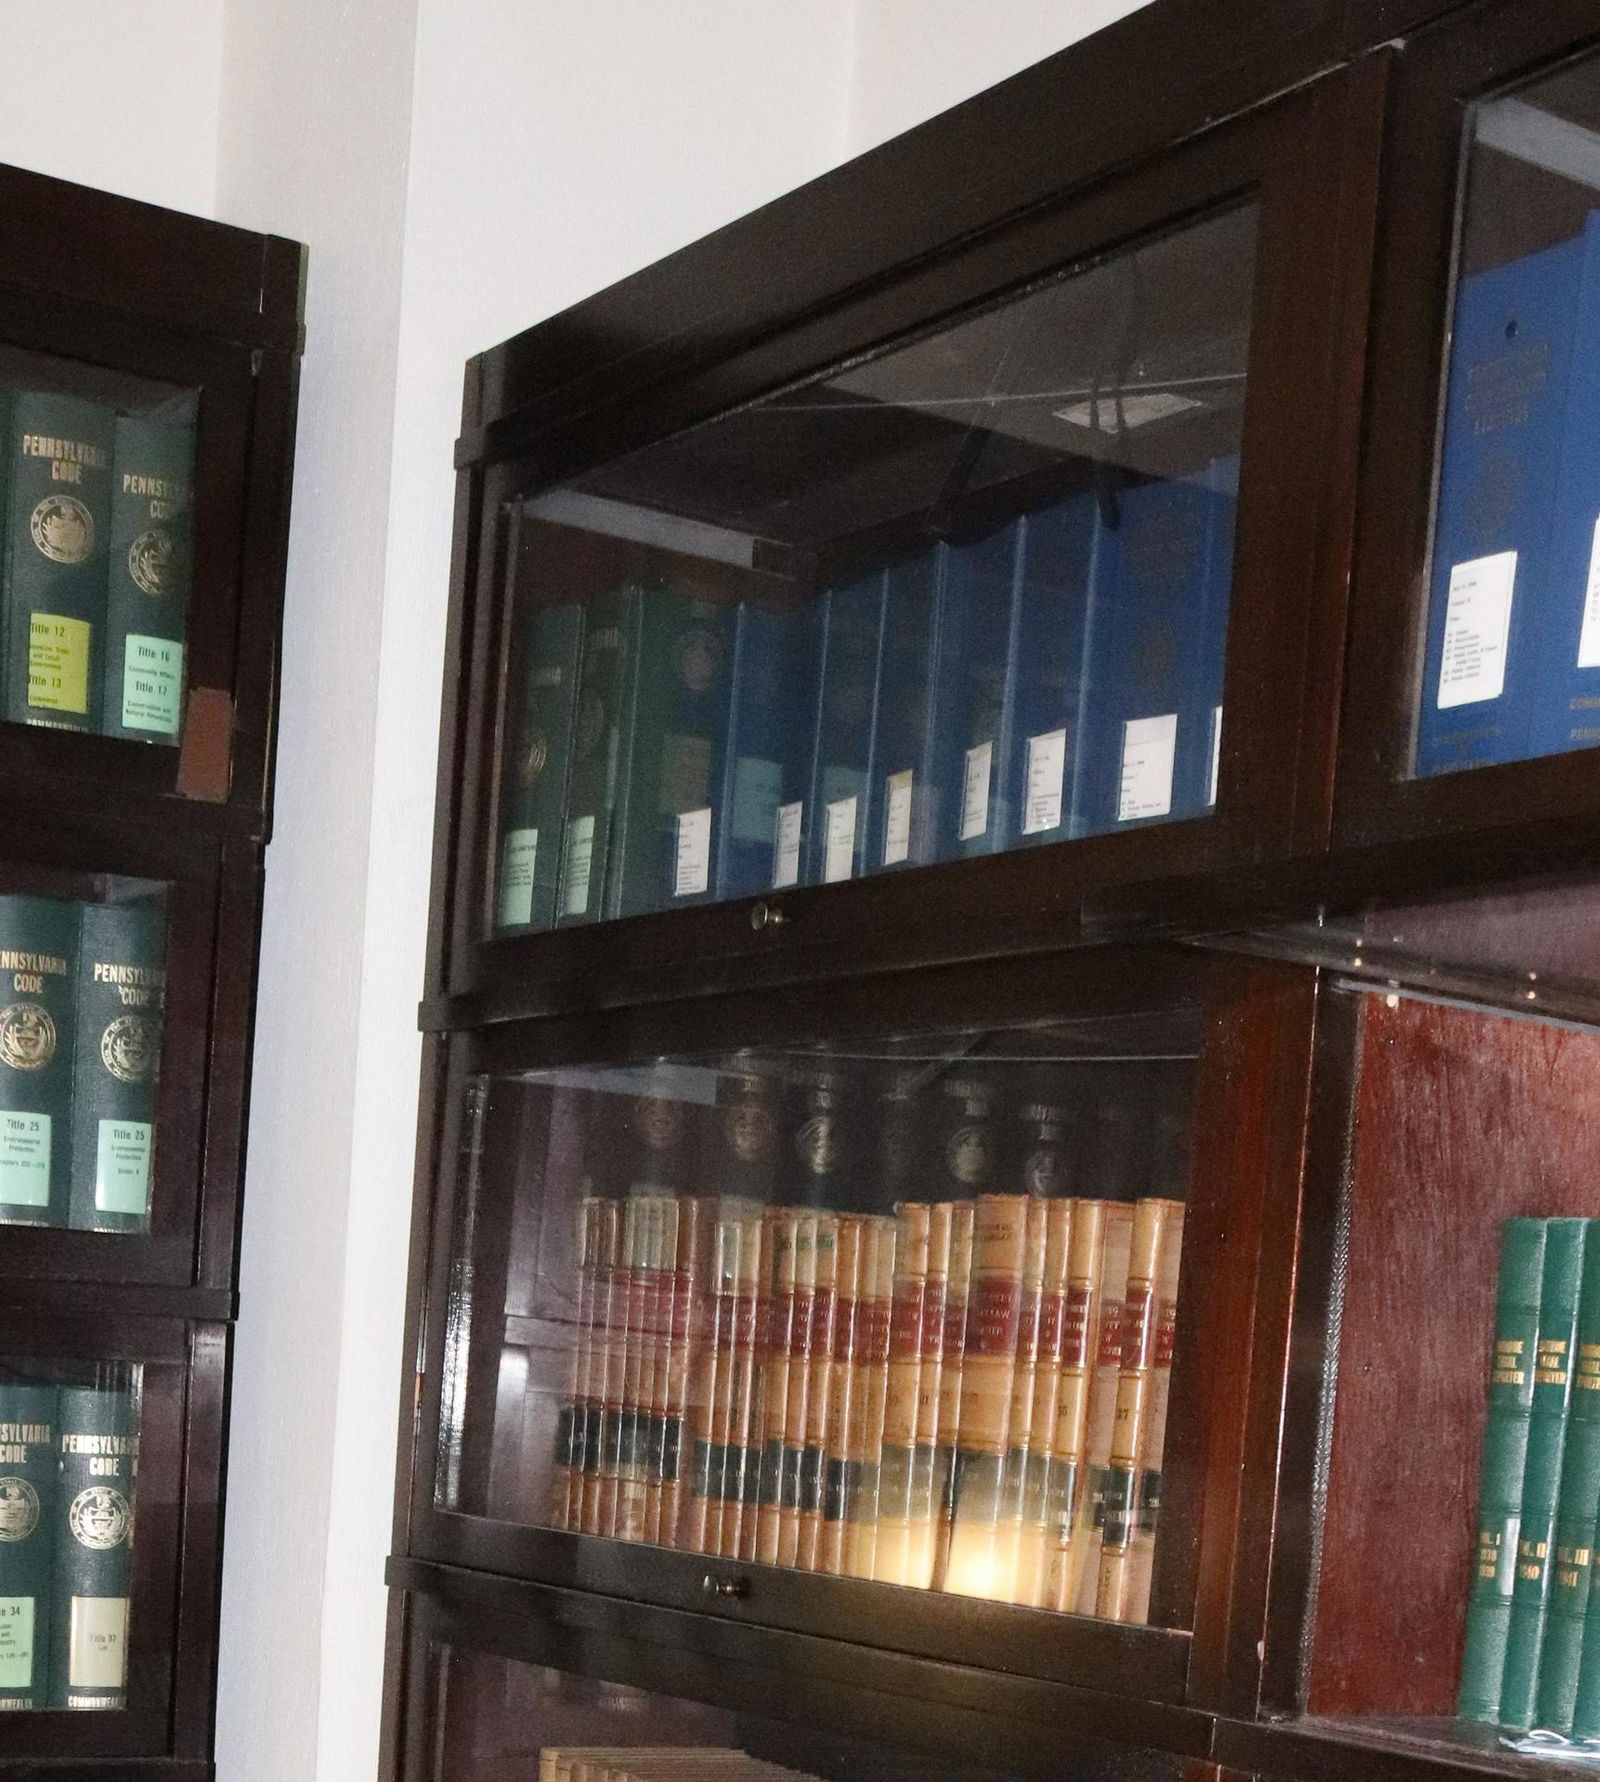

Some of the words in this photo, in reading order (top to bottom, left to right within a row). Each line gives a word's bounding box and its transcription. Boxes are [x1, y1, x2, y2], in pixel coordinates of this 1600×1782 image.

[55, 626, 65, 638] 12
[137, 646, 156, 658] Title
[135, 681, 154, 693] Title
[158, 685, 168, 697] 17
[14, 973, 44, 994] CODE
[121, 986, 151, 1006] CODE
[7, 1119, 26, 1130] Title
[30, 1121, 40, 1131] 25
[113, 1129, 131, 1140] Title
[135, 1130, 145, 1141] 25
[0, 1444, 27, 1464] CODE
[89, 1456, 120, 1477] CODE
[11, 1606, 20, 1616] 34
